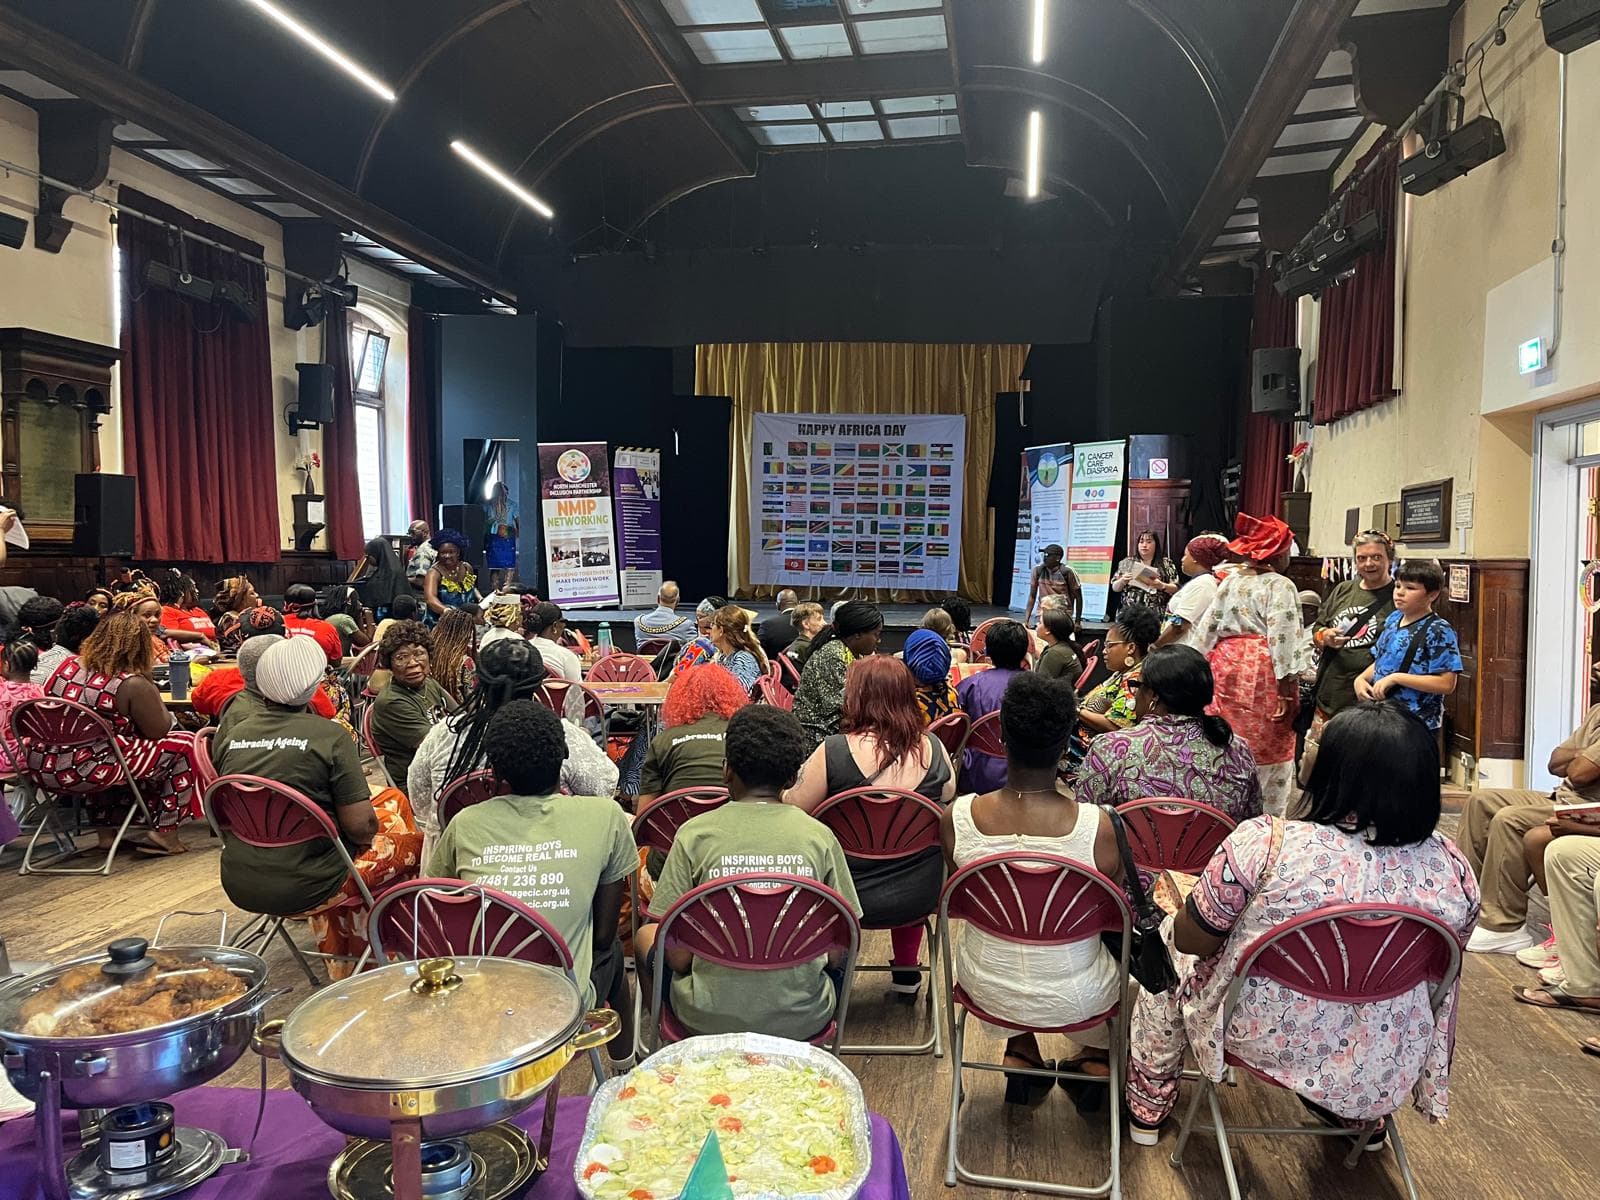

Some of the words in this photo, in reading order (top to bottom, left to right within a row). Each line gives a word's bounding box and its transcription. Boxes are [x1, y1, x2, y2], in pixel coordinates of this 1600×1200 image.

[798, 424, 836, 435] HAPPY
[838, 424, 881, 436] AFRICA
[883, 424, 906, 436] DAY
[1087, 451, 1114, 461] CANCER
[1086, 465, 1119, 475] DIASPORA
[1087, 460, 1104, 468] CARE
[557, 499, 597, 516] NMIP
[547, 515, 609, 527] NETWORKING
[229, 739, 274, 750] Embracing
[274, 737, 308, 751] Ageing
[672, 733, 723, 746] Embracing
[483, 844, 532, 855] INSPIRING
[536, 840, 562, 851] BOYS
[471, 857, 482, 867] TO
[483, 854, 523, 864] BECOME
[526, 850, 552, 862] REAL
[555, 849, 577, 859] MEN
[721, 855, 774, 866] INSPIRING
[777, 855, 803, 865] BOYS
[500, 864, 526, 873] Contact
[528, 864, 537, 873] Us
[708, 868, 720, 879] TO
[512, 875, 537, 887] 236
[540, 872, 564, 885] 890
[748, 881, 772, 889] ontact
